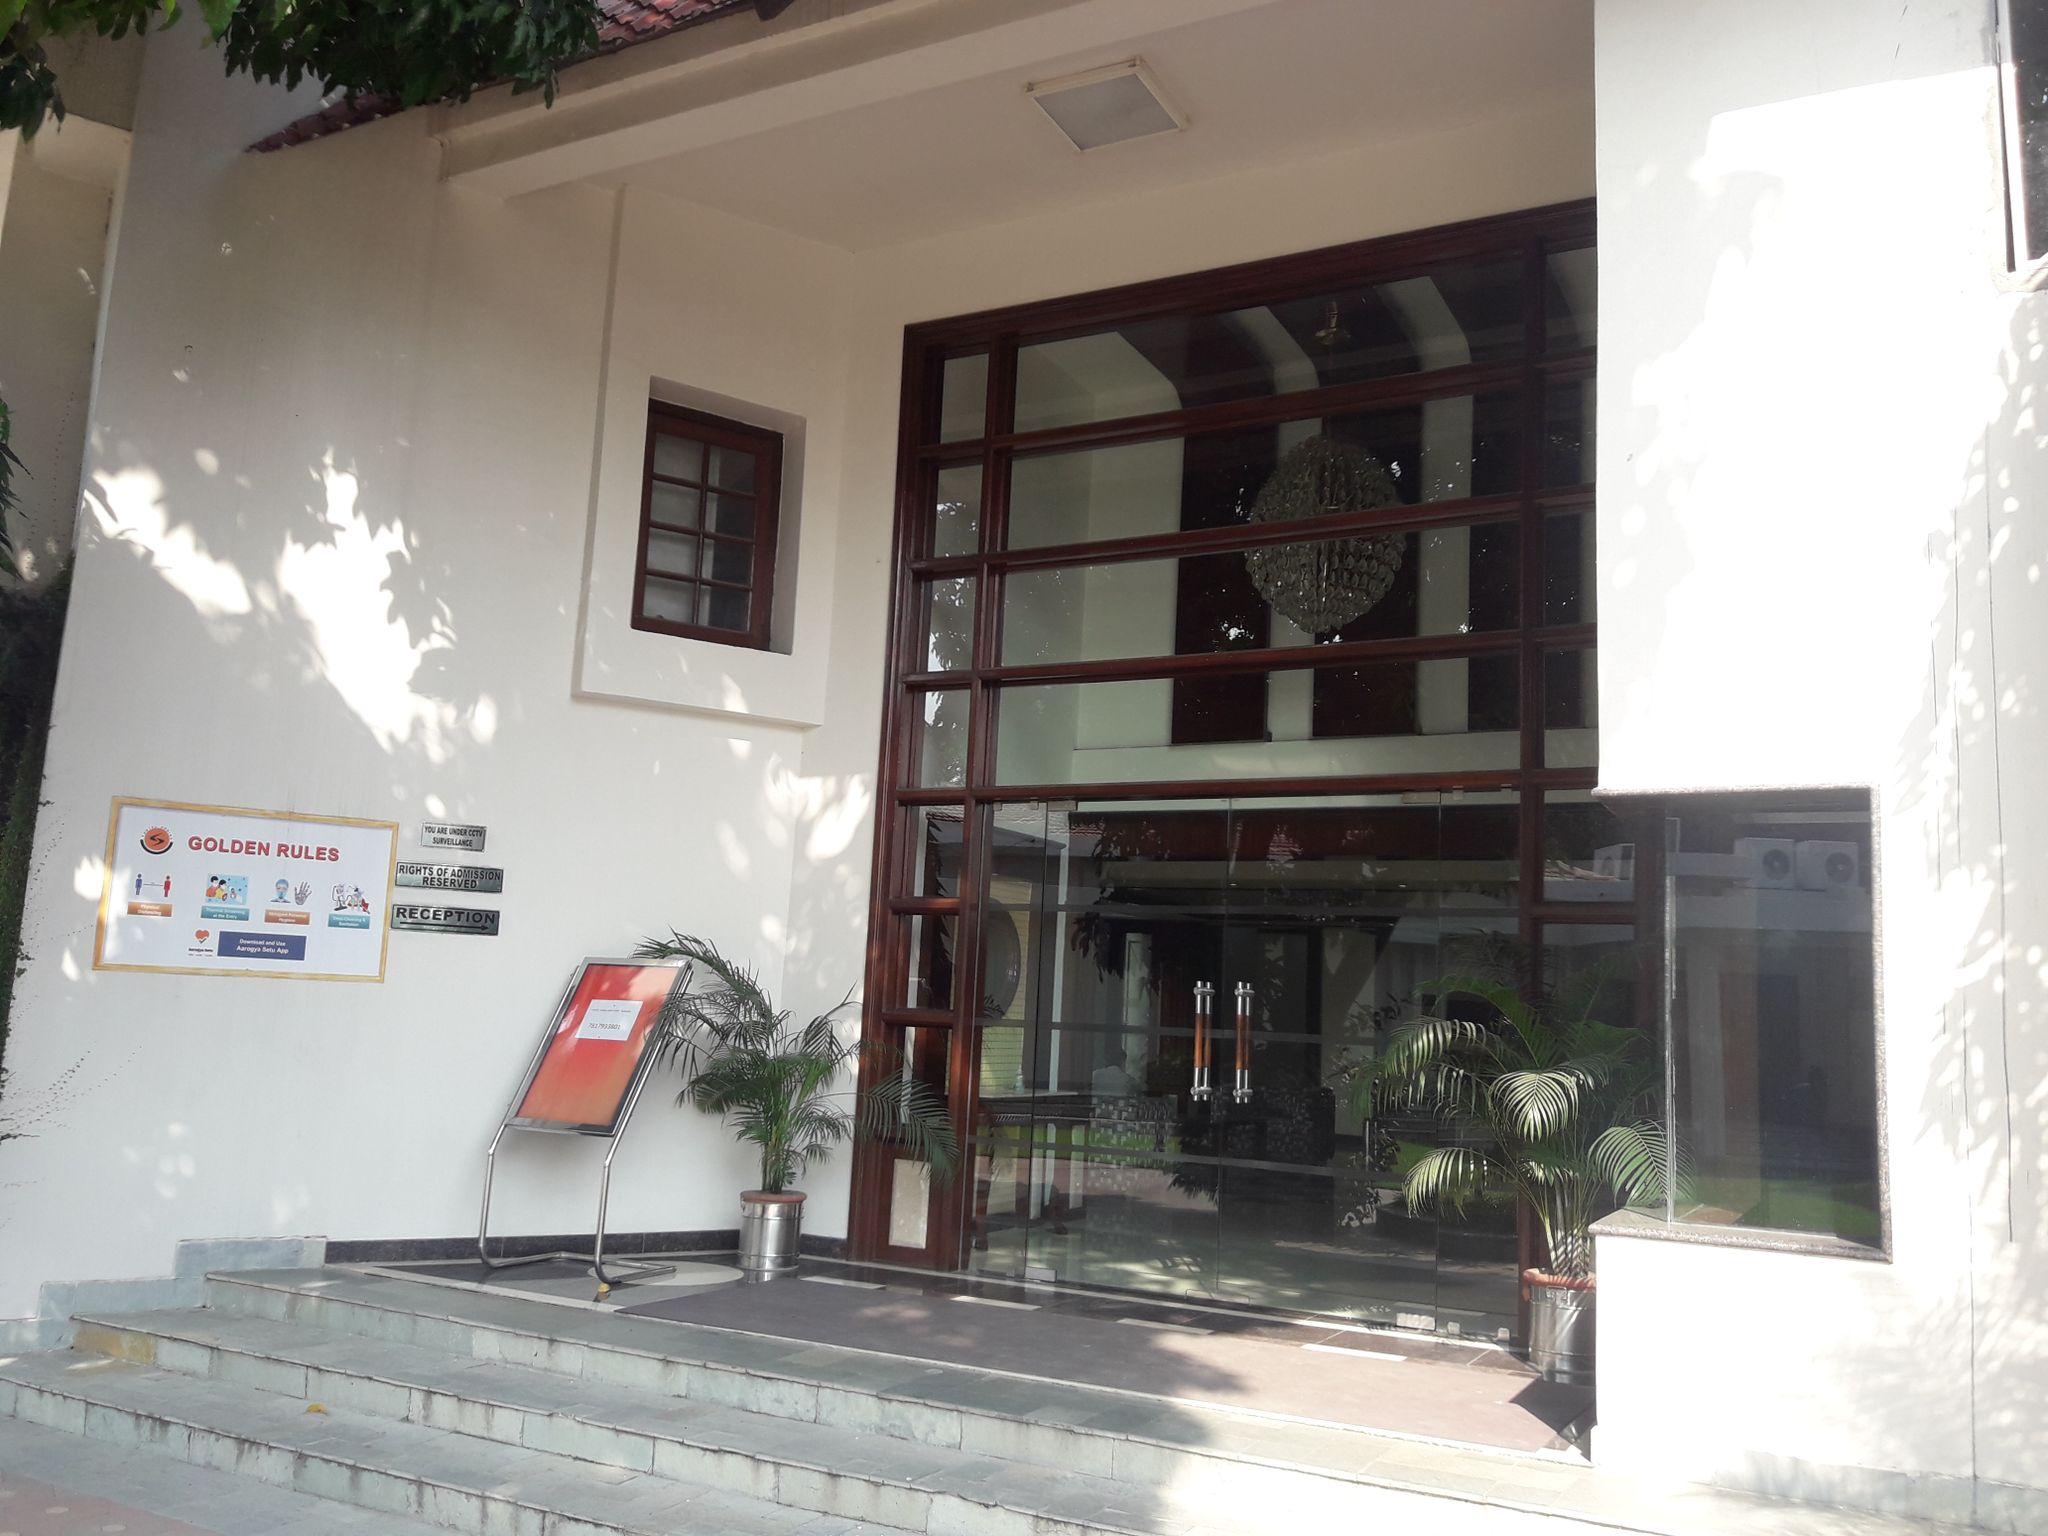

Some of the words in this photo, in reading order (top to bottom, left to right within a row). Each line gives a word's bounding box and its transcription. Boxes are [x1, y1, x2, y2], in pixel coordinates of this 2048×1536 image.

[424, 826, 436, 834] YOU
[437, 827, 448, 835] ARE
[449, 827, 467, 836] UNDER
[468, 829, 483, 838] CCTV
[432, 837, 473, 847] SURVEILLANCE
[187, 835, 270, 857] GOLDEN
[276, 843, 340, 862] RULES
[398, 864, 434, 876] RIGHTS
[436, 868, 448, 877] OF
[450, 868, 501, 881] ADMISSION
[422, 876, 477, 889] RESERVED
[395, 907, 496, 924] RECEPTION
[239, 938, 265, 946] Download
[236, 945, 261, 954] Aarogya
[276, 947, 289, 955] App
